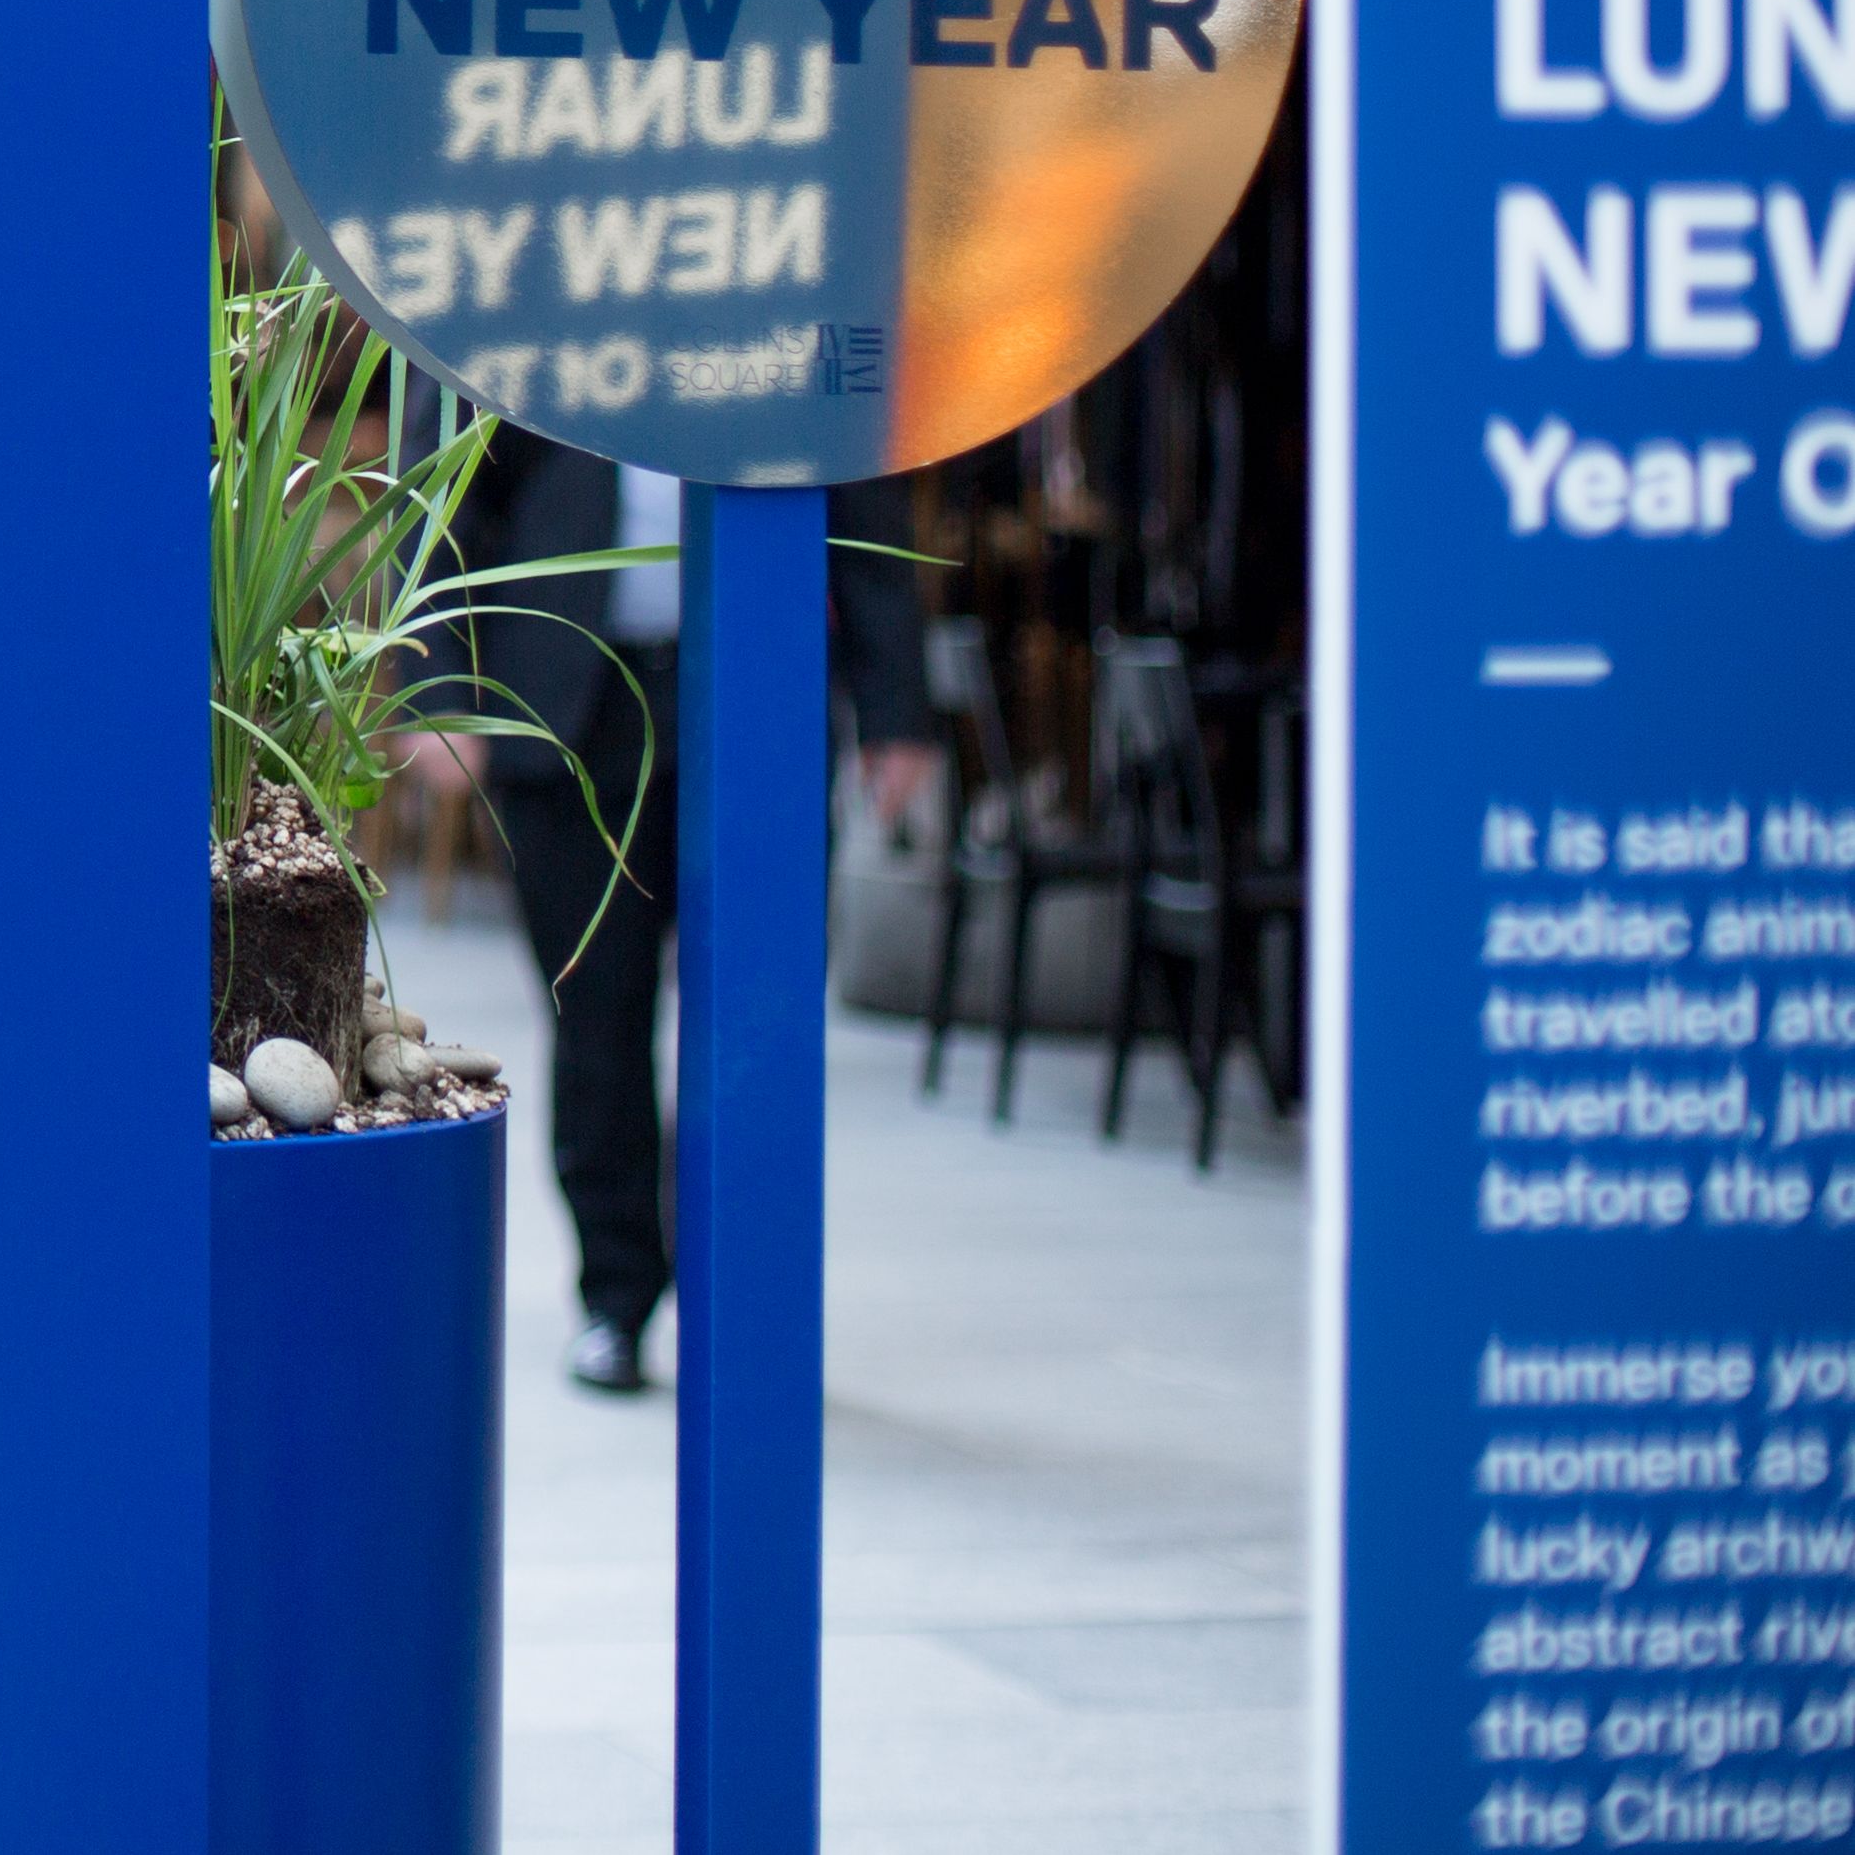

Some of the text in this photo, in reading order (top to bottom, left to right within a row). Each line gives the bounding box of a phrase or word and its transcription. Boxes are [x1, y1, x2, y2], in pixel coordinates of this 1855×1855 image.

[667, 324, 807, 355] COLLINS
[667, 361, 806, 393] SQUARE
[1485, 416, 1754, 536] Year
[1485, 806, 1538, 871] It
[1546, 808, 1606, 871] is
[1614, 802, 1749, 873] said
[1485, 894, 1691, 964] zodiac
[1484, 981, 1759, 1050] travelled
[1481, 1158, 1691, 1230] before
[1702, 1156, 1812, 1226] the
[1480, 1341, 1754, 1406] Immerse
[1476, 1428, 1741, 1496] moment
[1751, 1433, 1830, 1491] as
[1475, 1516, 1651, 1592] lucky
[1471, 1604, 1744, 1672] abstract
[1471, 1694, 1588, 1762] the
[1596, 1691, 1781, 1772] origin
[1471, 1778, 1853, 1848] the Chinese
